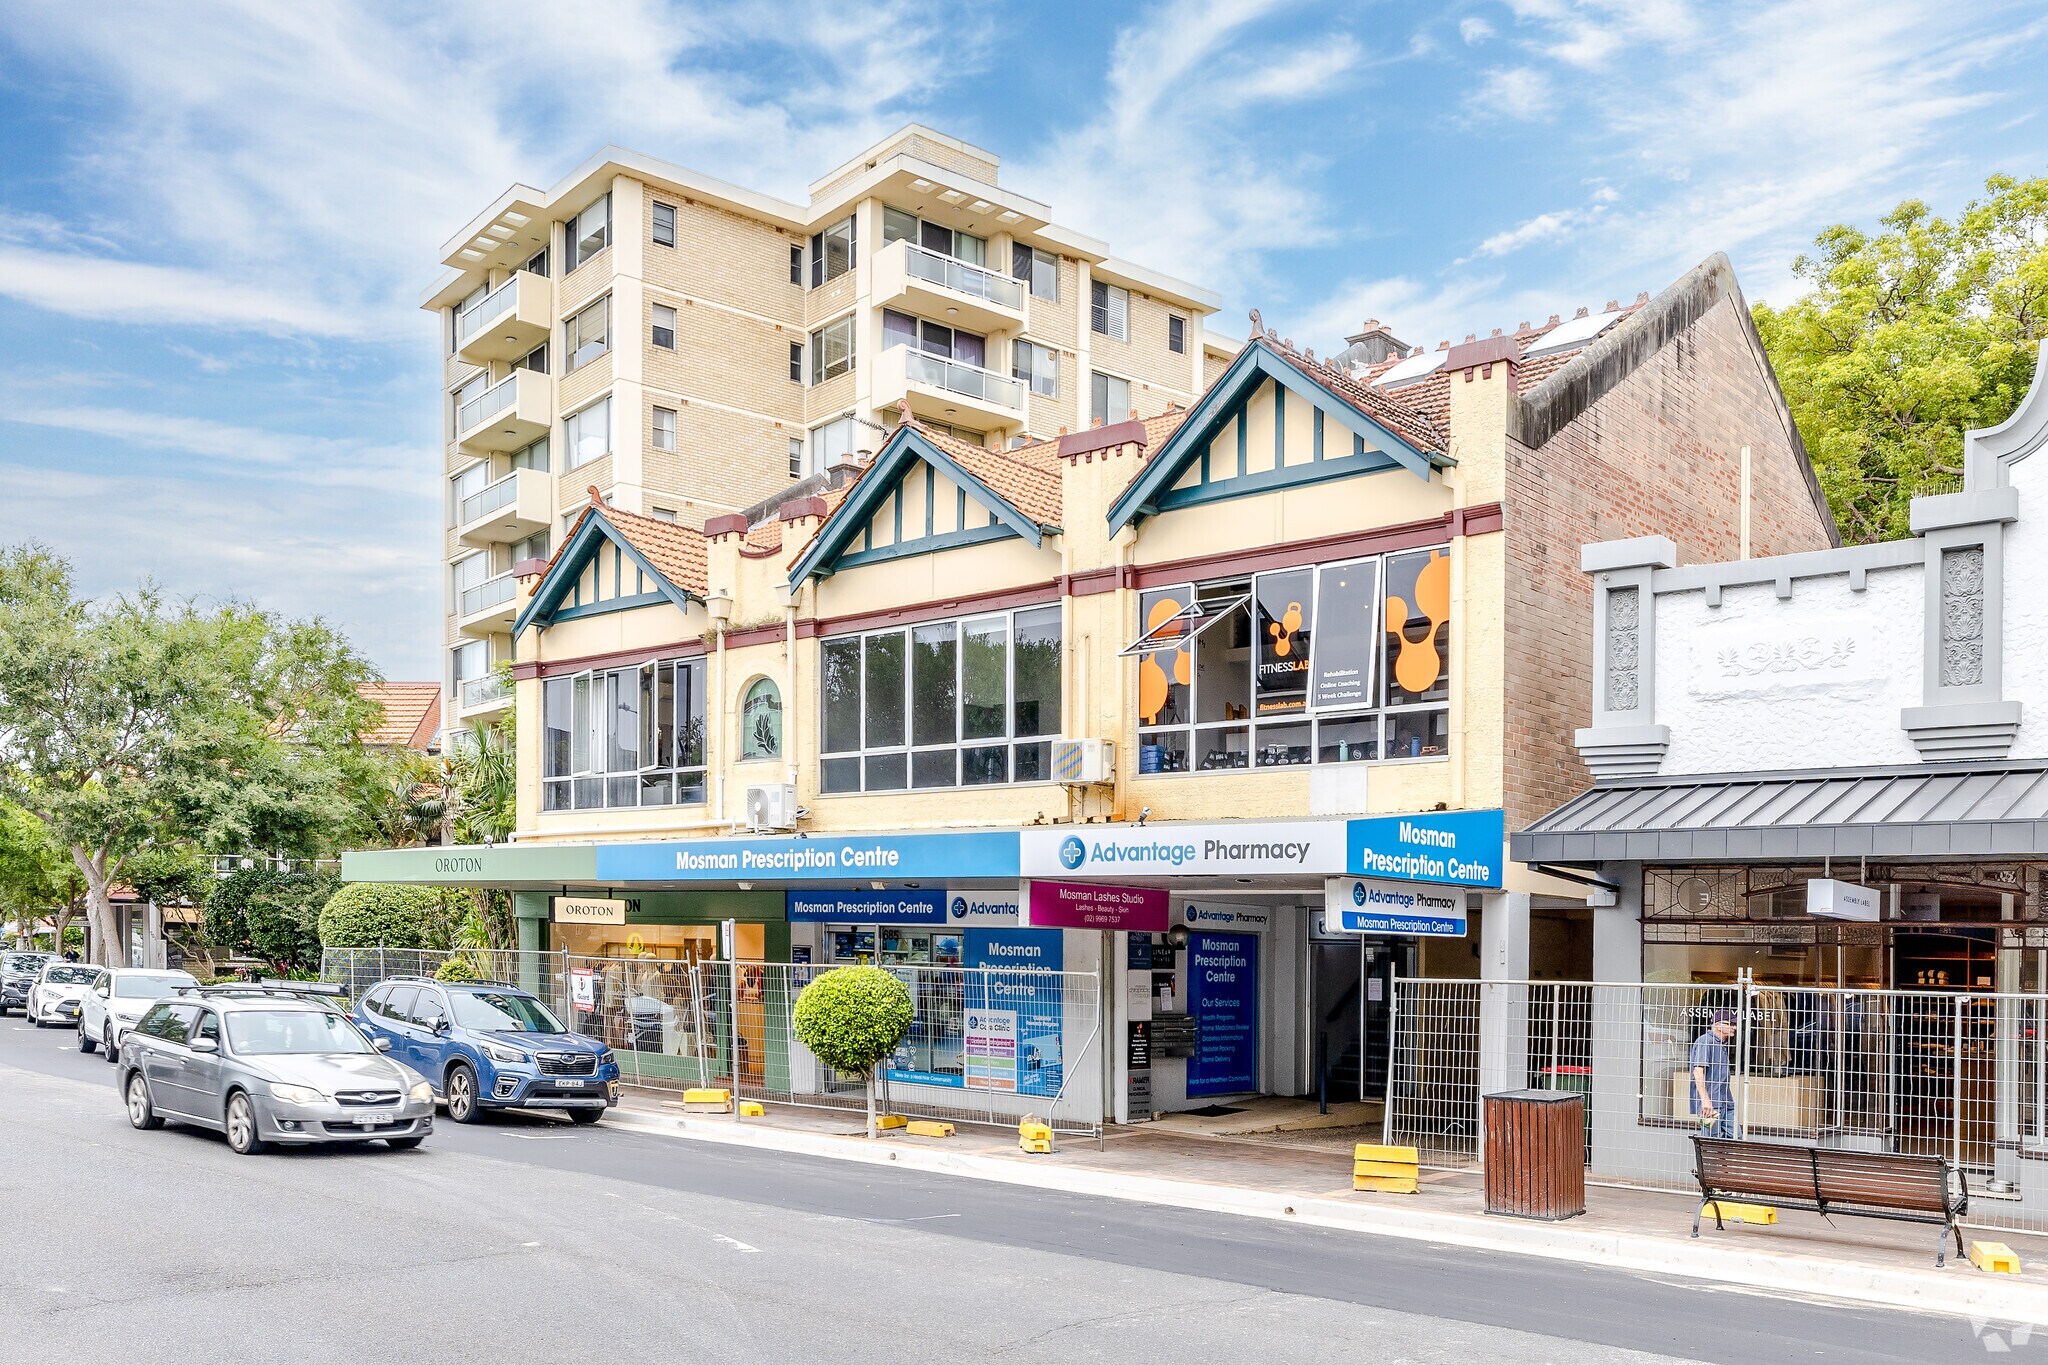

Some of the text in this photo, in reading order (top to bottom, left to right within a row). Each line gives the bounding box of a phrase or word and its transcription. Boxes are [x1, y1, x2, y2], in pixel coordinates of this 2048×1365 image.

[1259, 660, 1309, 674] FITNESSLAB
[1323, 669, 1359, 678] Rehabilitation
[1337, 680, 1361, 688] Coaching
[1337, 690, 1362, 698] Challenge
[1259, 701, 1307, 711] fitnesslab.com.a
[1399, 821, 1456, 849] Mosman
[676, 846, 899, 872] Mosman Prescription Centre
[1090, 839, 1311, 866] Advantage Pharmacy
[435, 857, 482, 872] OROTON
[1363, 847, 1490, 882] Prescription Centre
[1059, 888, 1144, 905] Mosman Lashes Studio
[1368, 888, 1456, 911] Advantage Pharmacy
[1843, 896, 1870, 907] ASSEMBLY LABEL
[565, 904, 614, 916] OROTON
[794, 901, 934, 917] Mosman Prescription Centre
[1075, 903, 1129, 914] Lashes Beauty Skin
[1084, 914, 1095, 923] (02)
[1198, 910, 1268, 925] Advantage Pharmacy
[1357, 916, 1389, 929] Mosman
[1390, 918, 1431, 932] Prescription
[1431, 919, 1454, 933] Centre
[882, 929, 899, 941] 685
[988, 942, 1041, 957] Mosman
[1202, 938, 1240, 951] Mosman
[1194, 954, 1246, 969] Prescription
[1206, 970, 1236, 982] Centre
[994, 981, 1036, 997] Centre
[1201, 997, 1240, 1007] Our Services
[1742, 1011, 1776, 1022] LABEL
